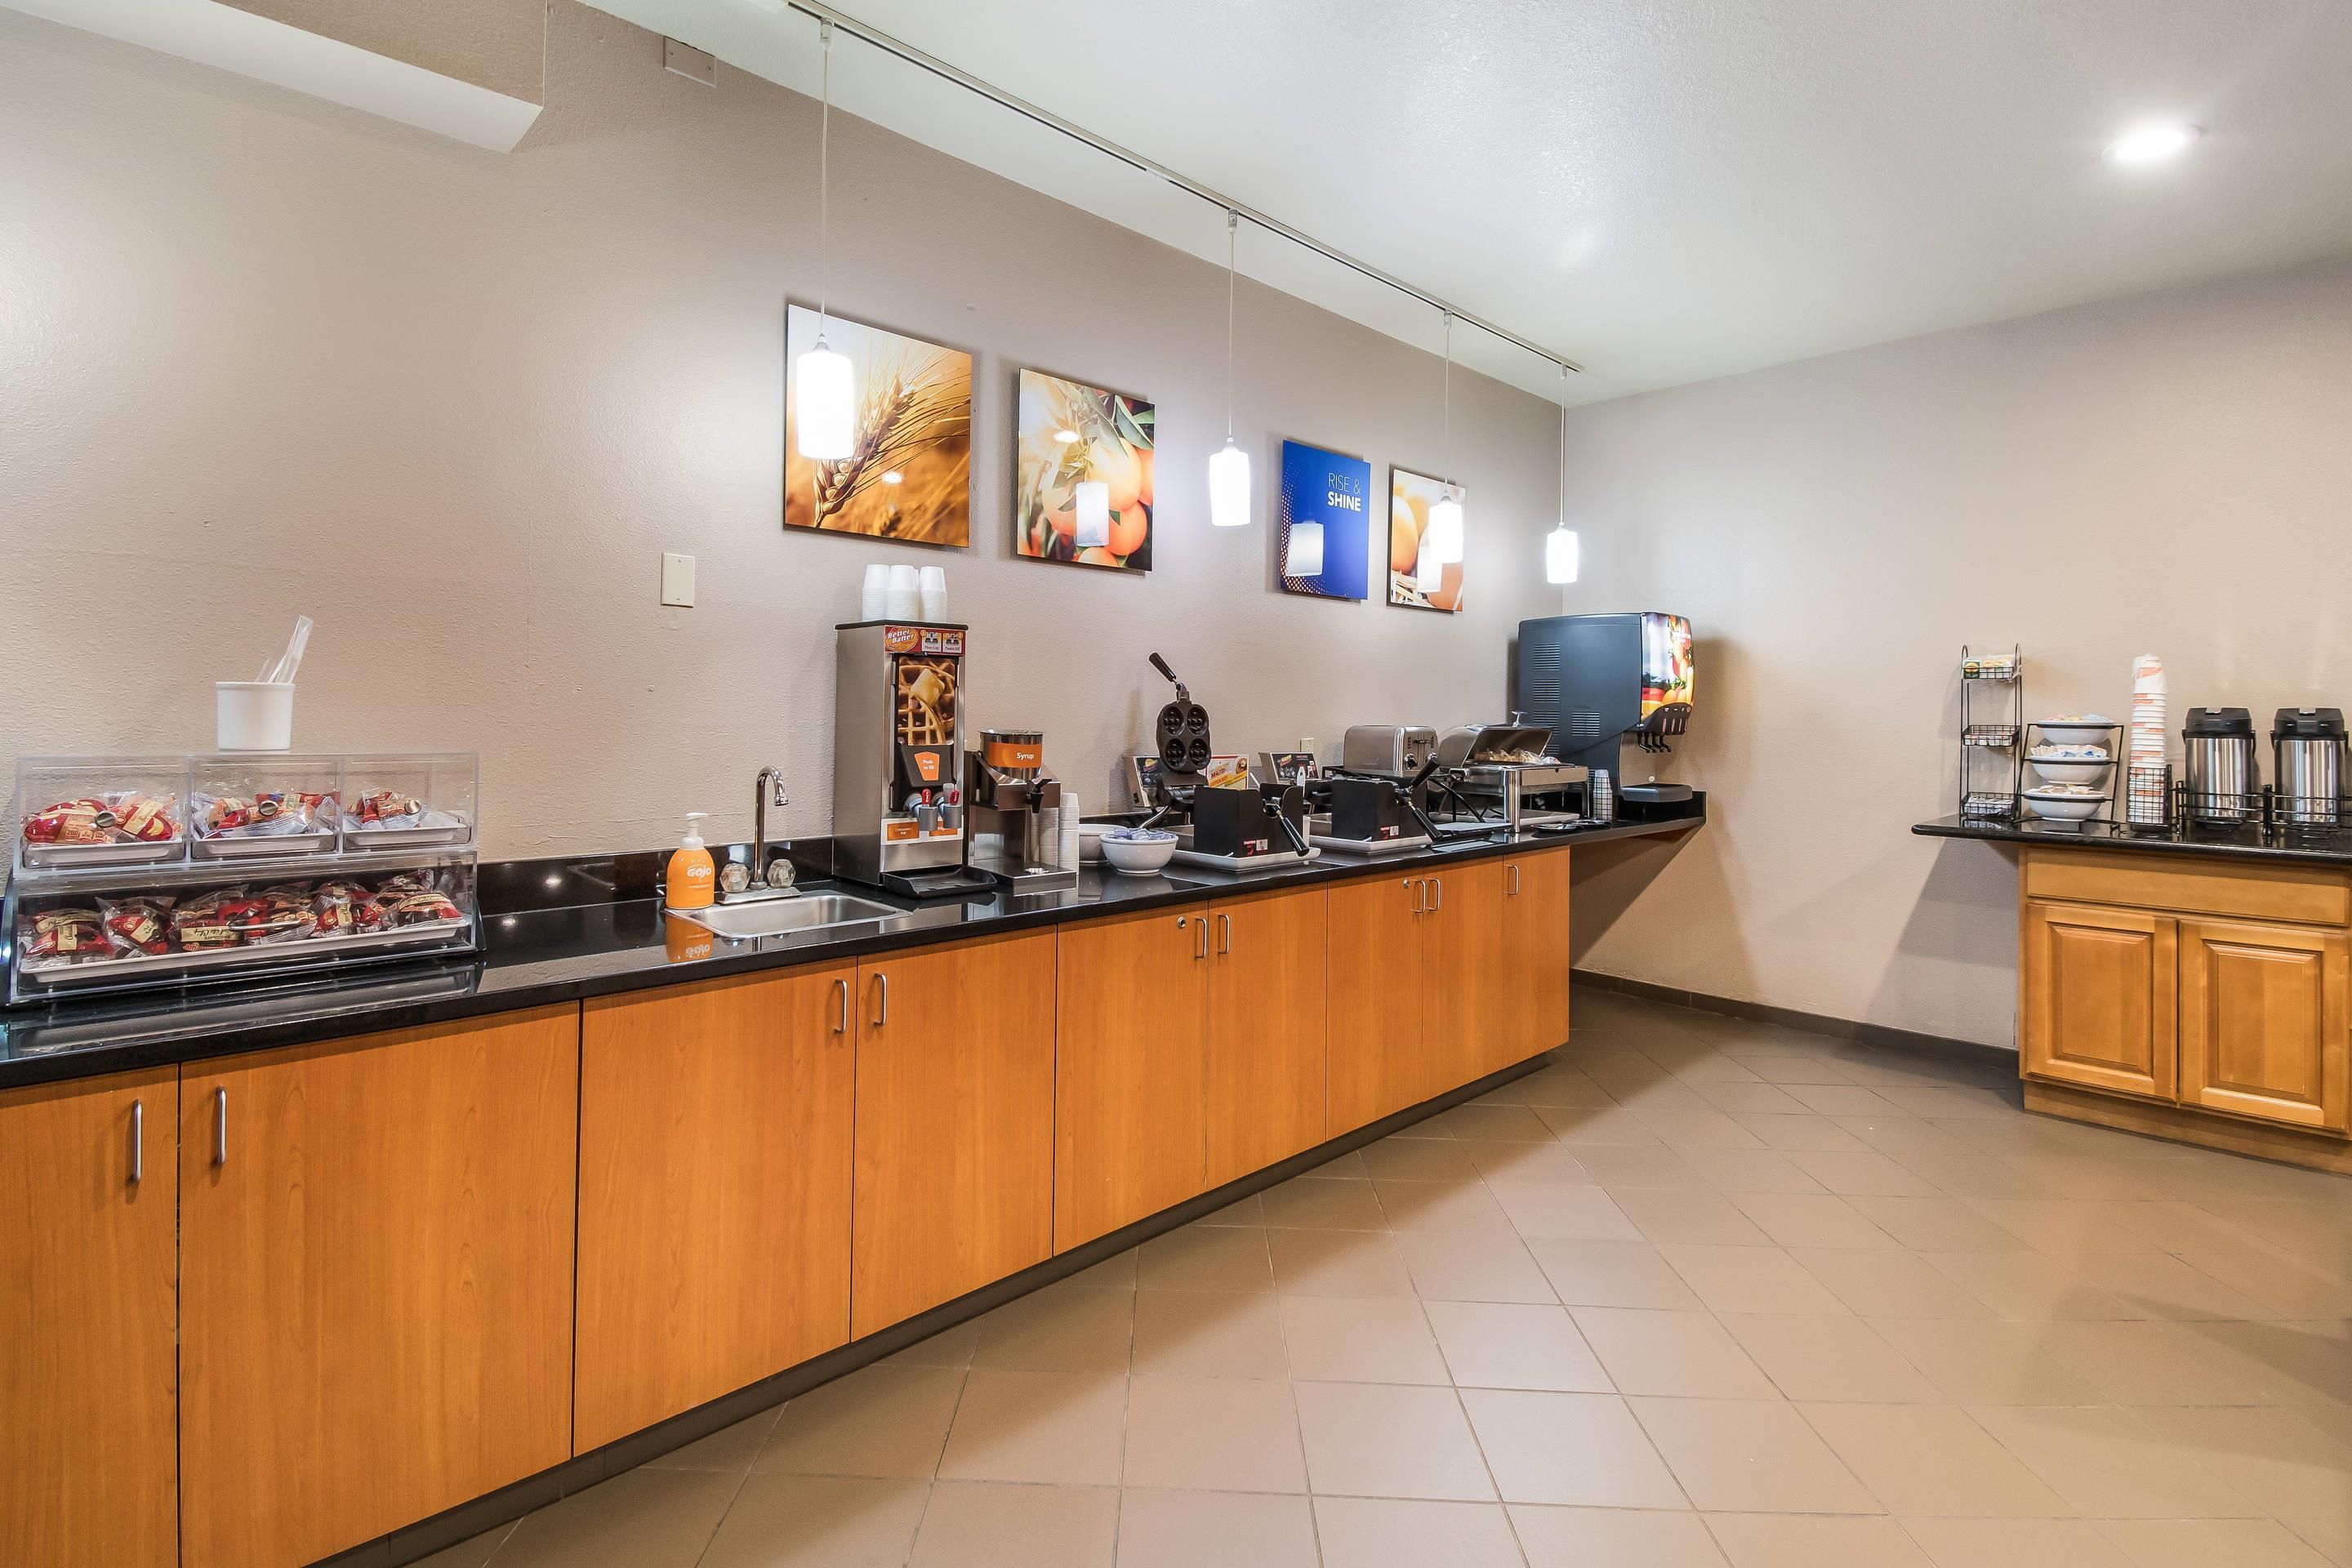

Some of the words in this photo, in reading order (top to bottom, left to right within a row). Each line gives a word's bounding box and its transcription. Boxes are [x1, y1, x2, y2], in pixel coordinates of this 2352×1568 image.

[1328, 472, 1351, 492] RISE
[1353, 479, 1361, 495] &
[1327, 491, 1361, 512] SHINE
[1016, 752, 1035, 760] Syrup
